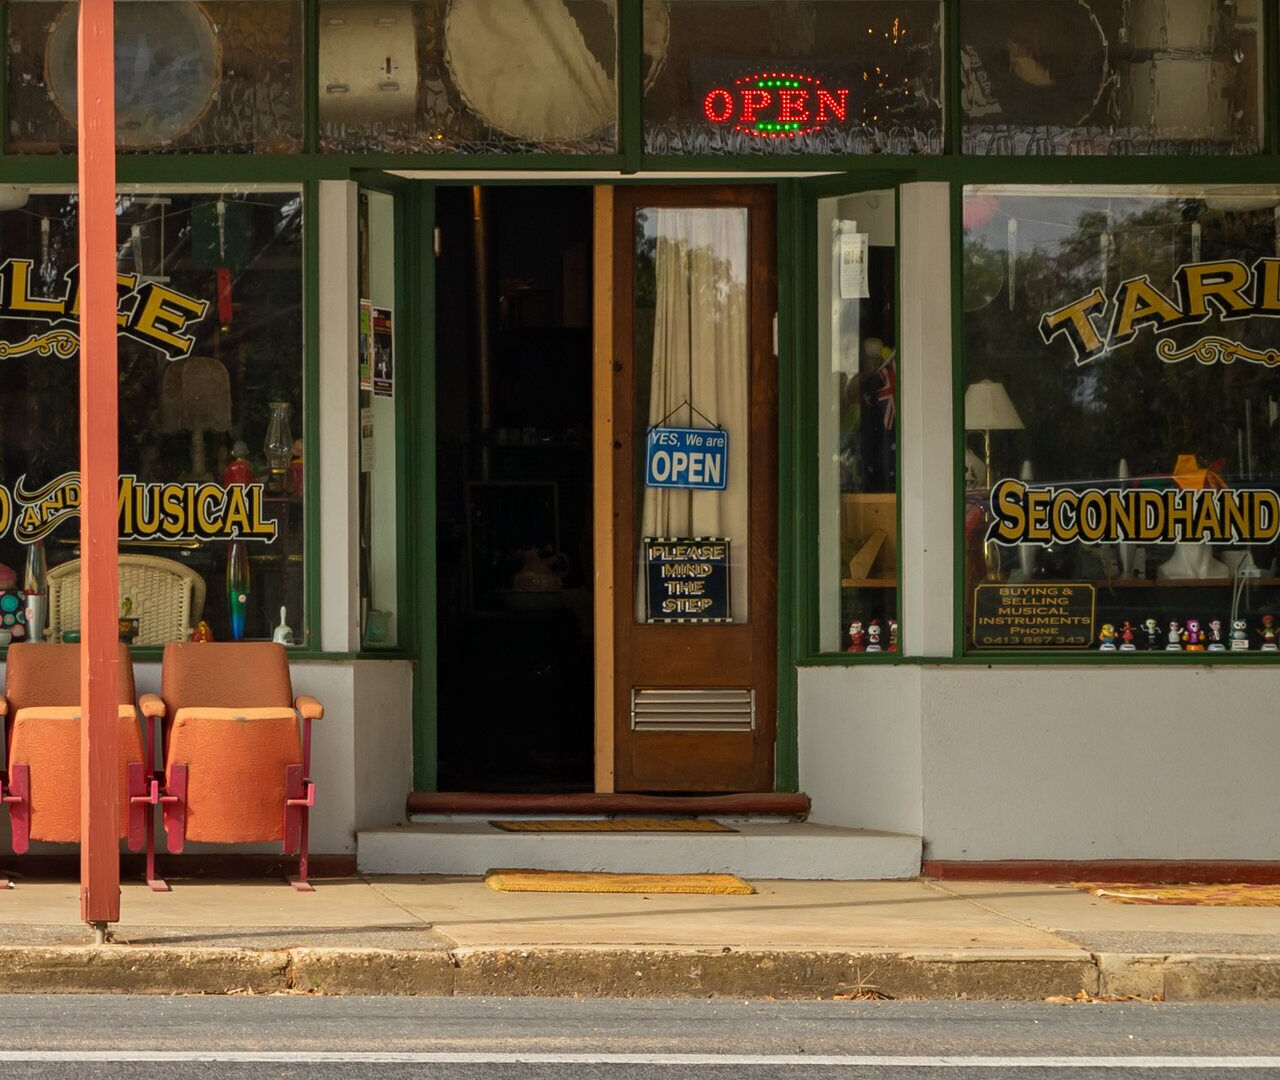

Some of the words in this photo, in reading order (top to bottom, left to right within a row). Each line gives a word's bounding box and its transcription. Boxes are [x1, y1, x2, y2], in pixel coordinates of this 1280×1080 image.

[703, 88, 849, 122] OPEN
[651, 432, 680, 447] YES,
[686, 434, 703, 446] We
[706, 437, 724, 447] are
[652, 450, 721, 483] OPEN
[988, 478, 1280, 546] SECONDHAND
[648, 546, 725, 560] PLEASE
[661, 564, 713, 578] MIND
[664, 581, 705, 595] THE
[1062, 587, 1073, 596] &
[662, 598, 713, 613] STEP
[1001, 597, 1069, 605] SELLING
[998, 607, 1069, 615] MUSICAL
[979, 617, 1091, 625] INSTRUMENTS
[983, 636, 1020, 644] 0413
